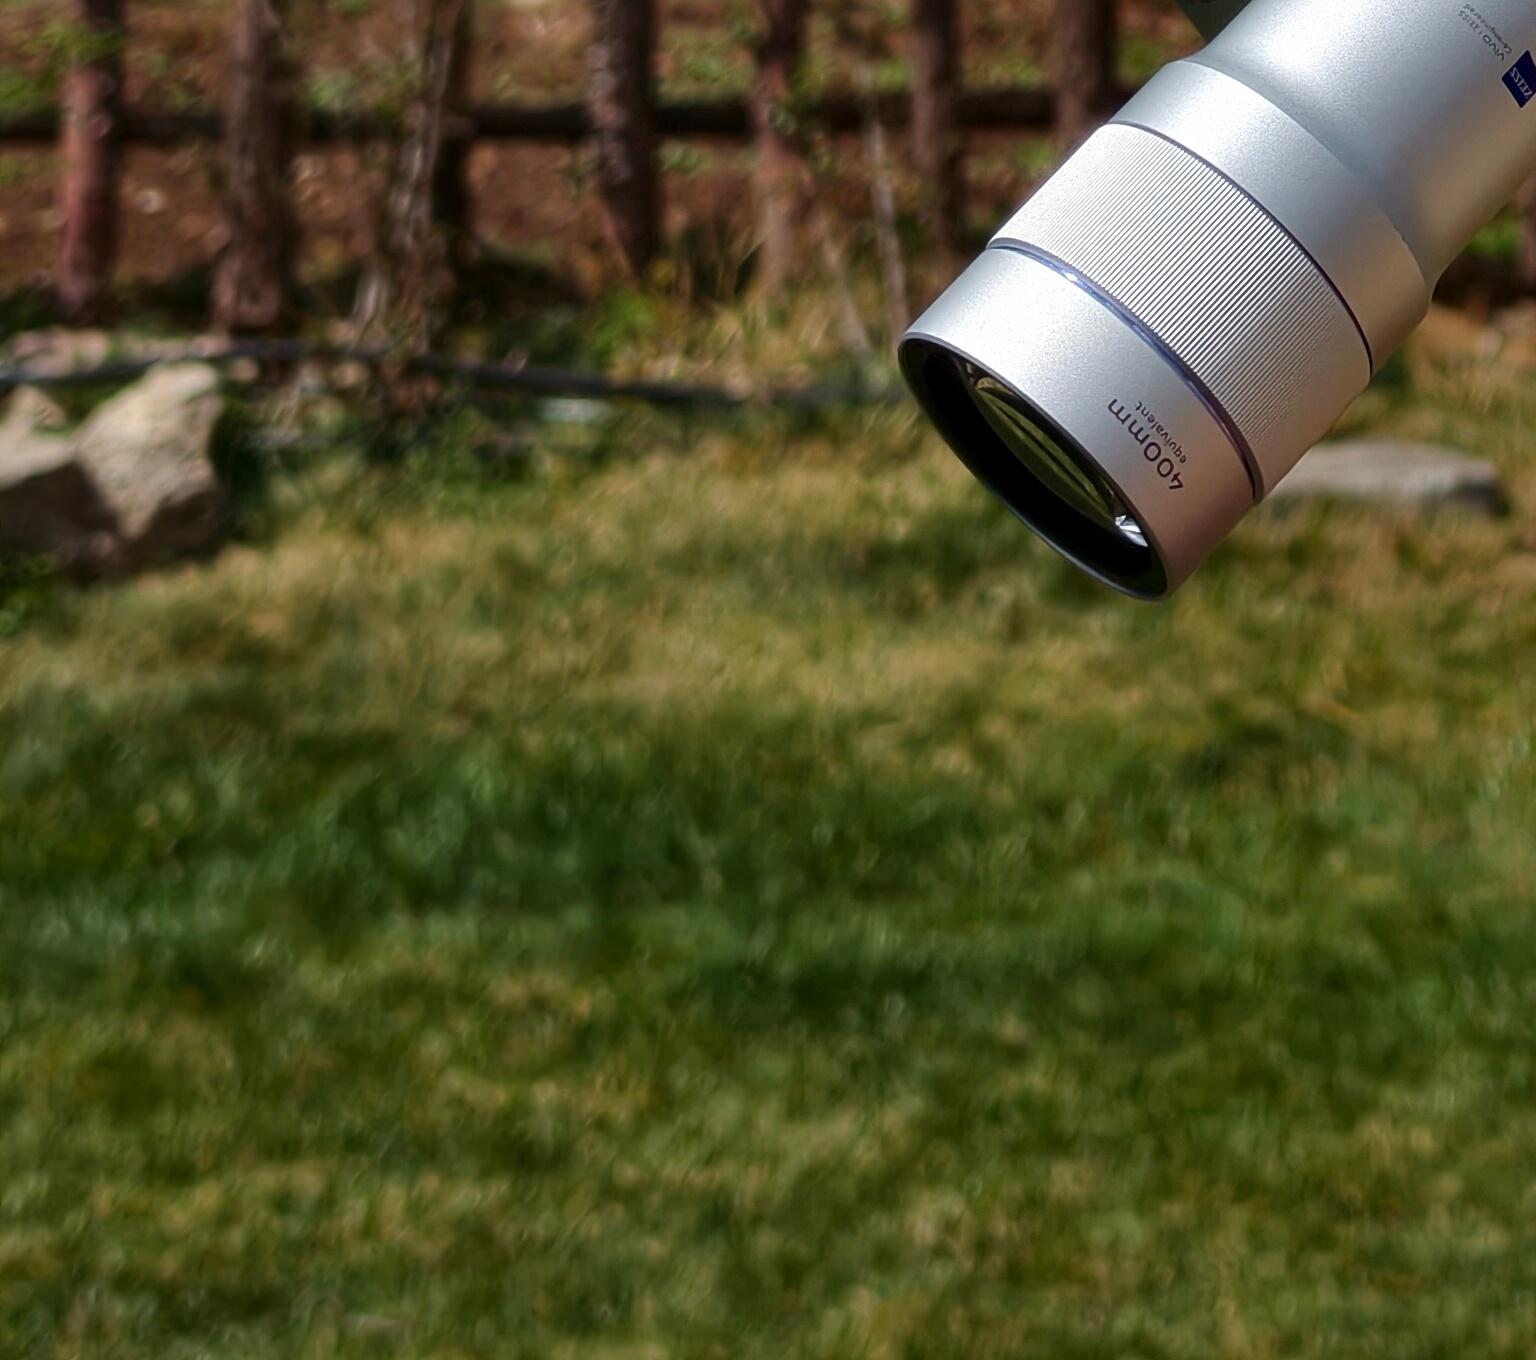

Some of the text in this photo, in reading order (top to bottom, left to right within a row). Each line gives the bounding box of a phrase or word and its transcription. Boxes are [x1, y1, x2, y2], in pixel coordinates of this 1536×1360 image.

[1510, 66, 1534, 99] ZEISS
[1107, 398, 1184, 490] 400mm
[1135, 401, 1187, 464] equivalent
